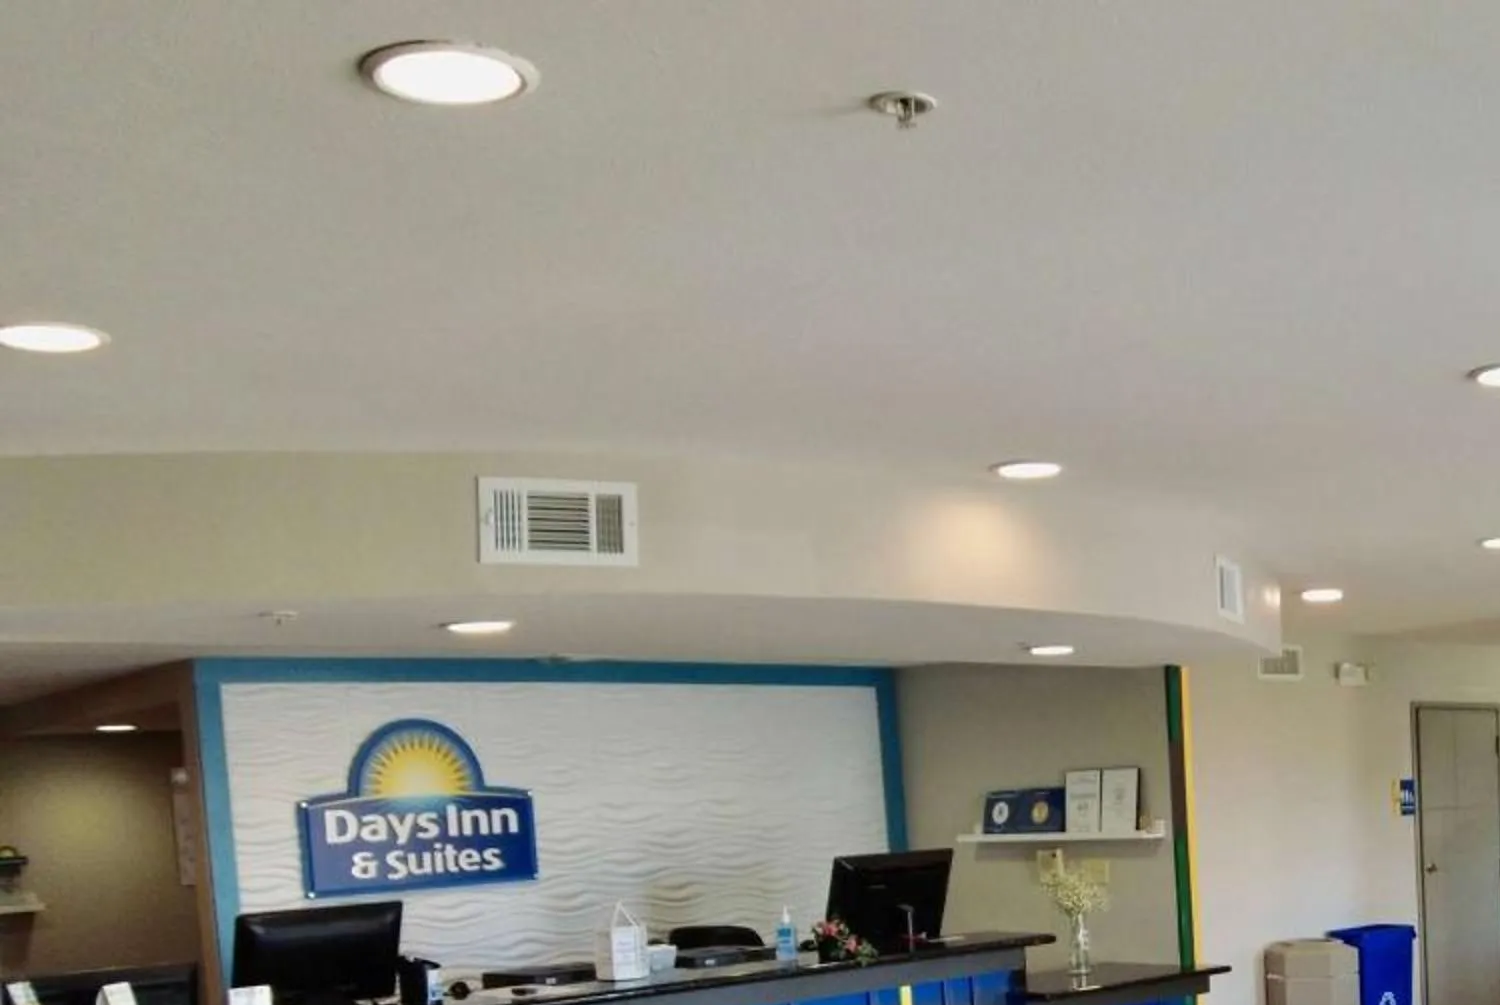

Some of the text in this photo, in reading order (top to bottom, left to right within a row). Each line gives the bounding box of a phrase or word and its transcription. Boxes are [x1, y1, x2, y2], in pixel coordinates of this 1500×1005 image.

[324, 804, 519, 844] Days Inn
[351, 844, 504, 880] & Suites
